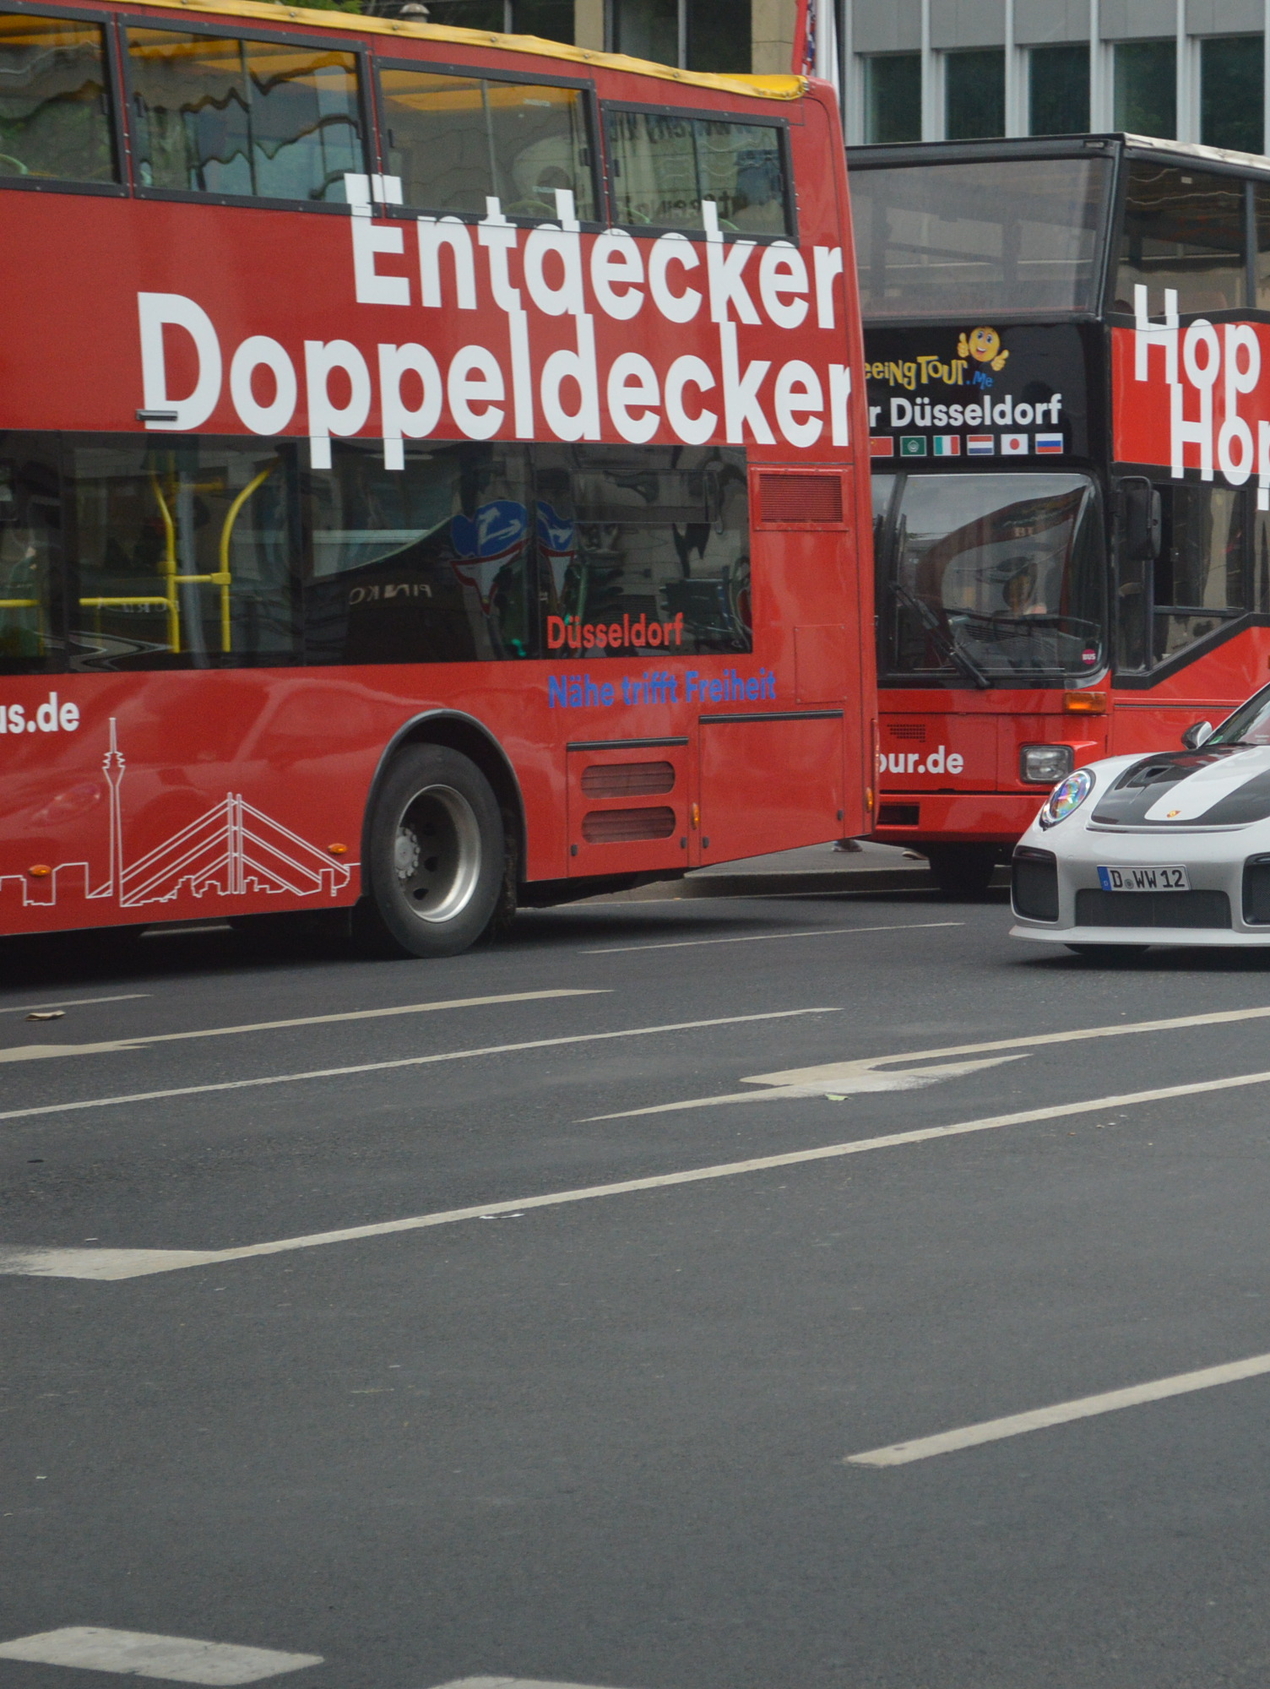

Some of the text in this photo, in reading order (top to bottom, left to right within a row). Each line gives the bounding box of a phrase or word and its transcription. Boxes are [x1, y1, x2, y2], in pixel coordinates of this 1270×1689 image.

[344, 173, 843, 330] Entdecker
[1134, 284, 1261, 419] Hop
[138, 292, 851, 471] Doppeldecker
[890, 393, 1063, 427] Düsseldorf
[546, 612, 684, 649] Düsseldorf
[547, 667, 777, 708] Nähe trifft Freiheit
[1109, 869, 1186, 888] D WW 12
